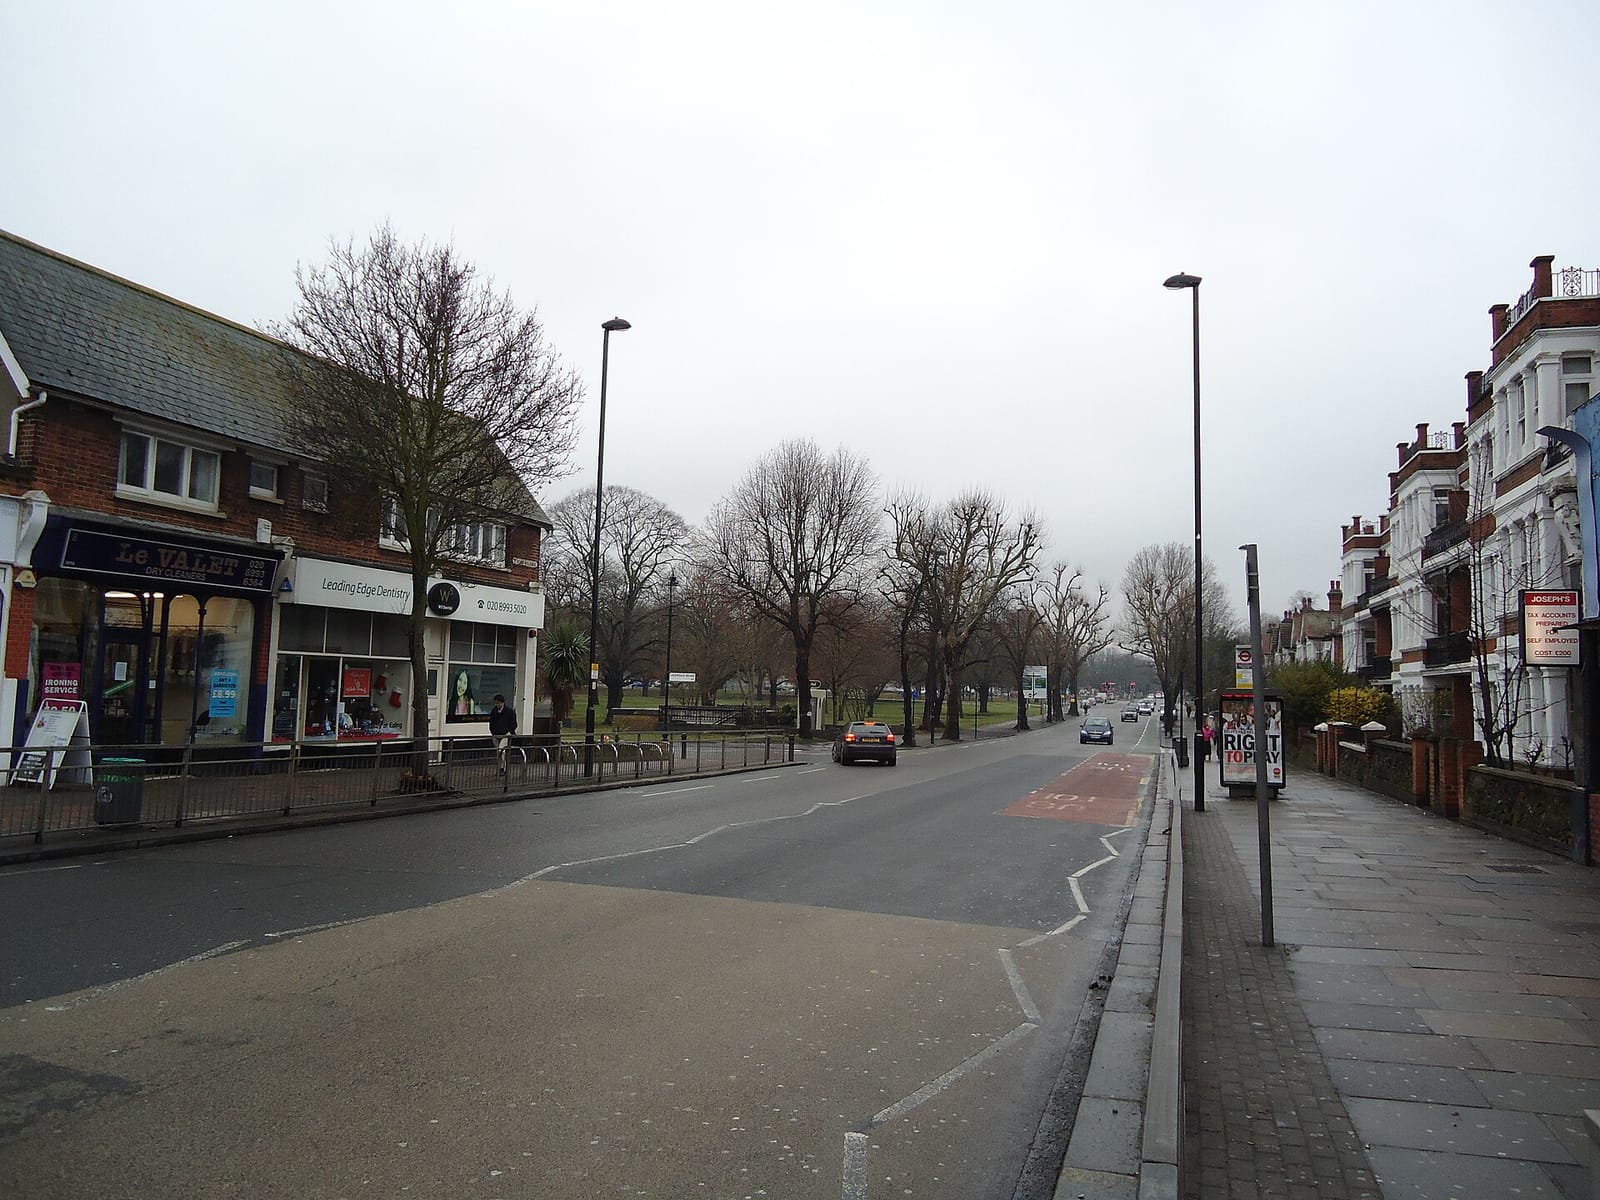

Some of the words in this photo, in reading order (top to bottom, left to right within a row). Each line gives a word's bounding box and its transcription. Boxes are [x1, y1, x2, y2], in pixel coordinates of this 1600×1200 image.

[117, 544, 149, 565] Le
[157, 547, 239, 577] VALET
[249, 560, 265, 569] 020
[145, 566, 164, 576] DRY
[164, 568, 207, 581] CLEANERS
[245, 568, 265, 578] 8993
[322, 578, 356, 596] Leading
[356, 582, 376, 597] Edge
[376, 585, 411, 602] Dentistry
[1531, 595, 1571, 603] JOSEPH'S
[487, 600, 498, 610] 020
[499, 602, 513, 613] 8993
[514, 604, 527, 614] 5020
[45, 679, 78, 687] IRONING
[44, 686, 78, 694] SERVICE
[1224, 734, 1280, 751] RIGT
[1225, 750, 1243, 763] TO
